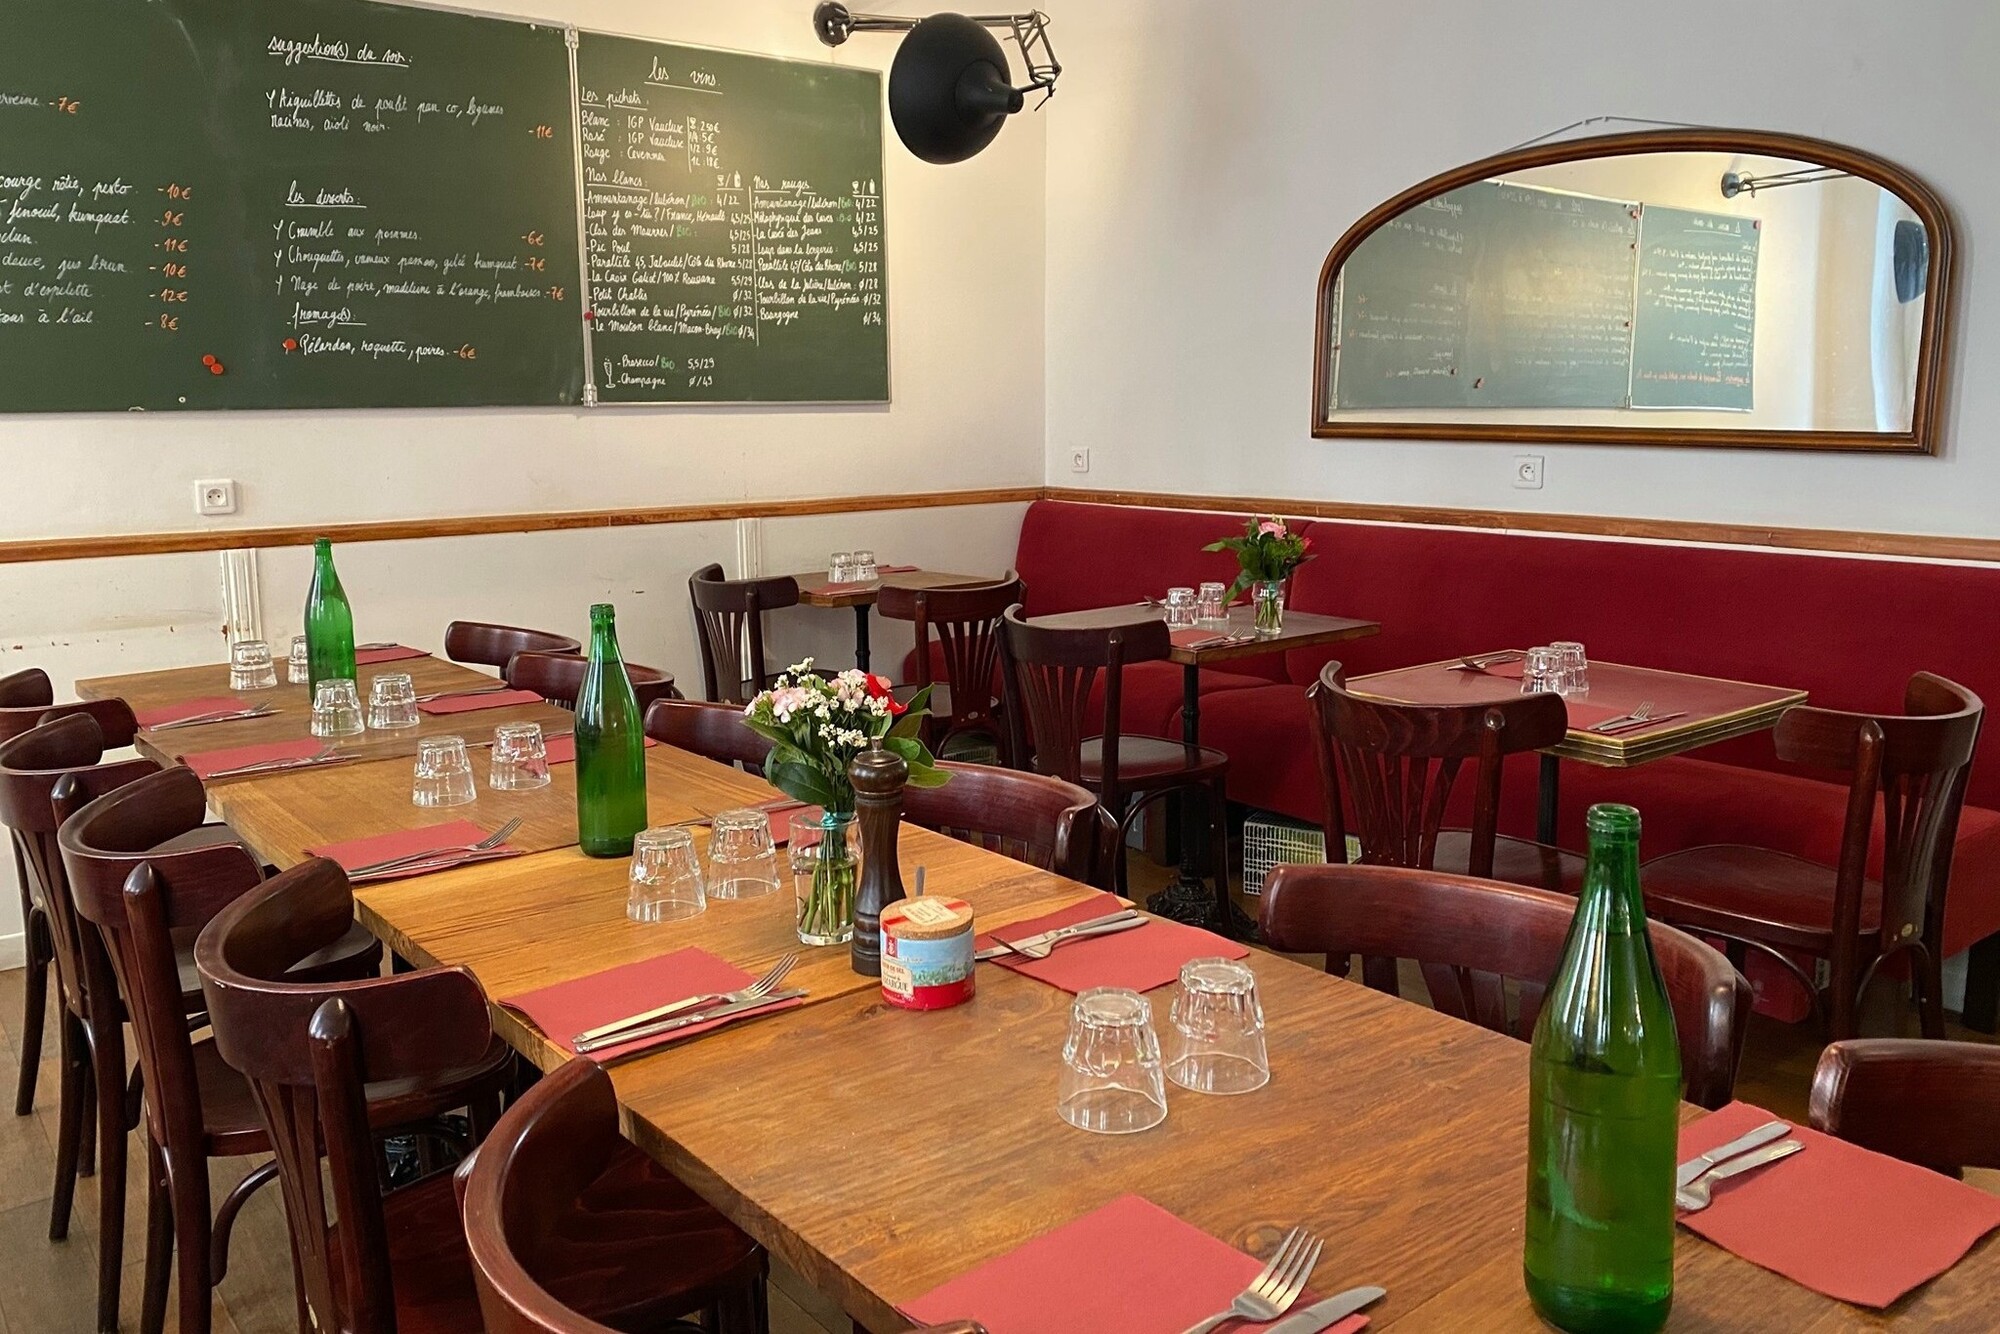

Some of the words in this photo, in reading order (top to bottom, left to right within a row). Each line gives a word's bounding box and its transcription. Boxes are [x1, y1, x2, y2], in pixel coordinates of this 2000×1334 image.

[357, 43, 376, 60] du
[352, 94, 365, 109] de
[582, 87, 598, 102] Les
[582, 110, 610, 127] Blanc
[628, 115, 644, 128] IGP
[649, 116, 684, 133] Vaucluse
[582, 127, 606, 141] Rosé
[628, 132, 644, 144] IGP
[649, 133, 684, 148] Vaucluse
[584, 143, 610, 164] Rouge
[586, 167, 607, 182] Nos
[753, 175, 770, 190] Nos
[288, 220, 334, 239] Crumble
[348, 227, 365, 237] aux
[612, 224, 627, 236] des
[612, 240, 631, 253] Poul
[57, 258, 81, 280] jus
[704, 255, 715, 268] du
[604, 270, 628, 283] Croix
[290, 275, 319, 297] Nage
[327, 277, 341, 291] de
[436, 284, 445, 295] à
[617, 286, 648, 301] Chablis
[640, 306, 650, 317] de
[652, 304, 662, 317] la
[608, 320, 643, 332] Mouton
